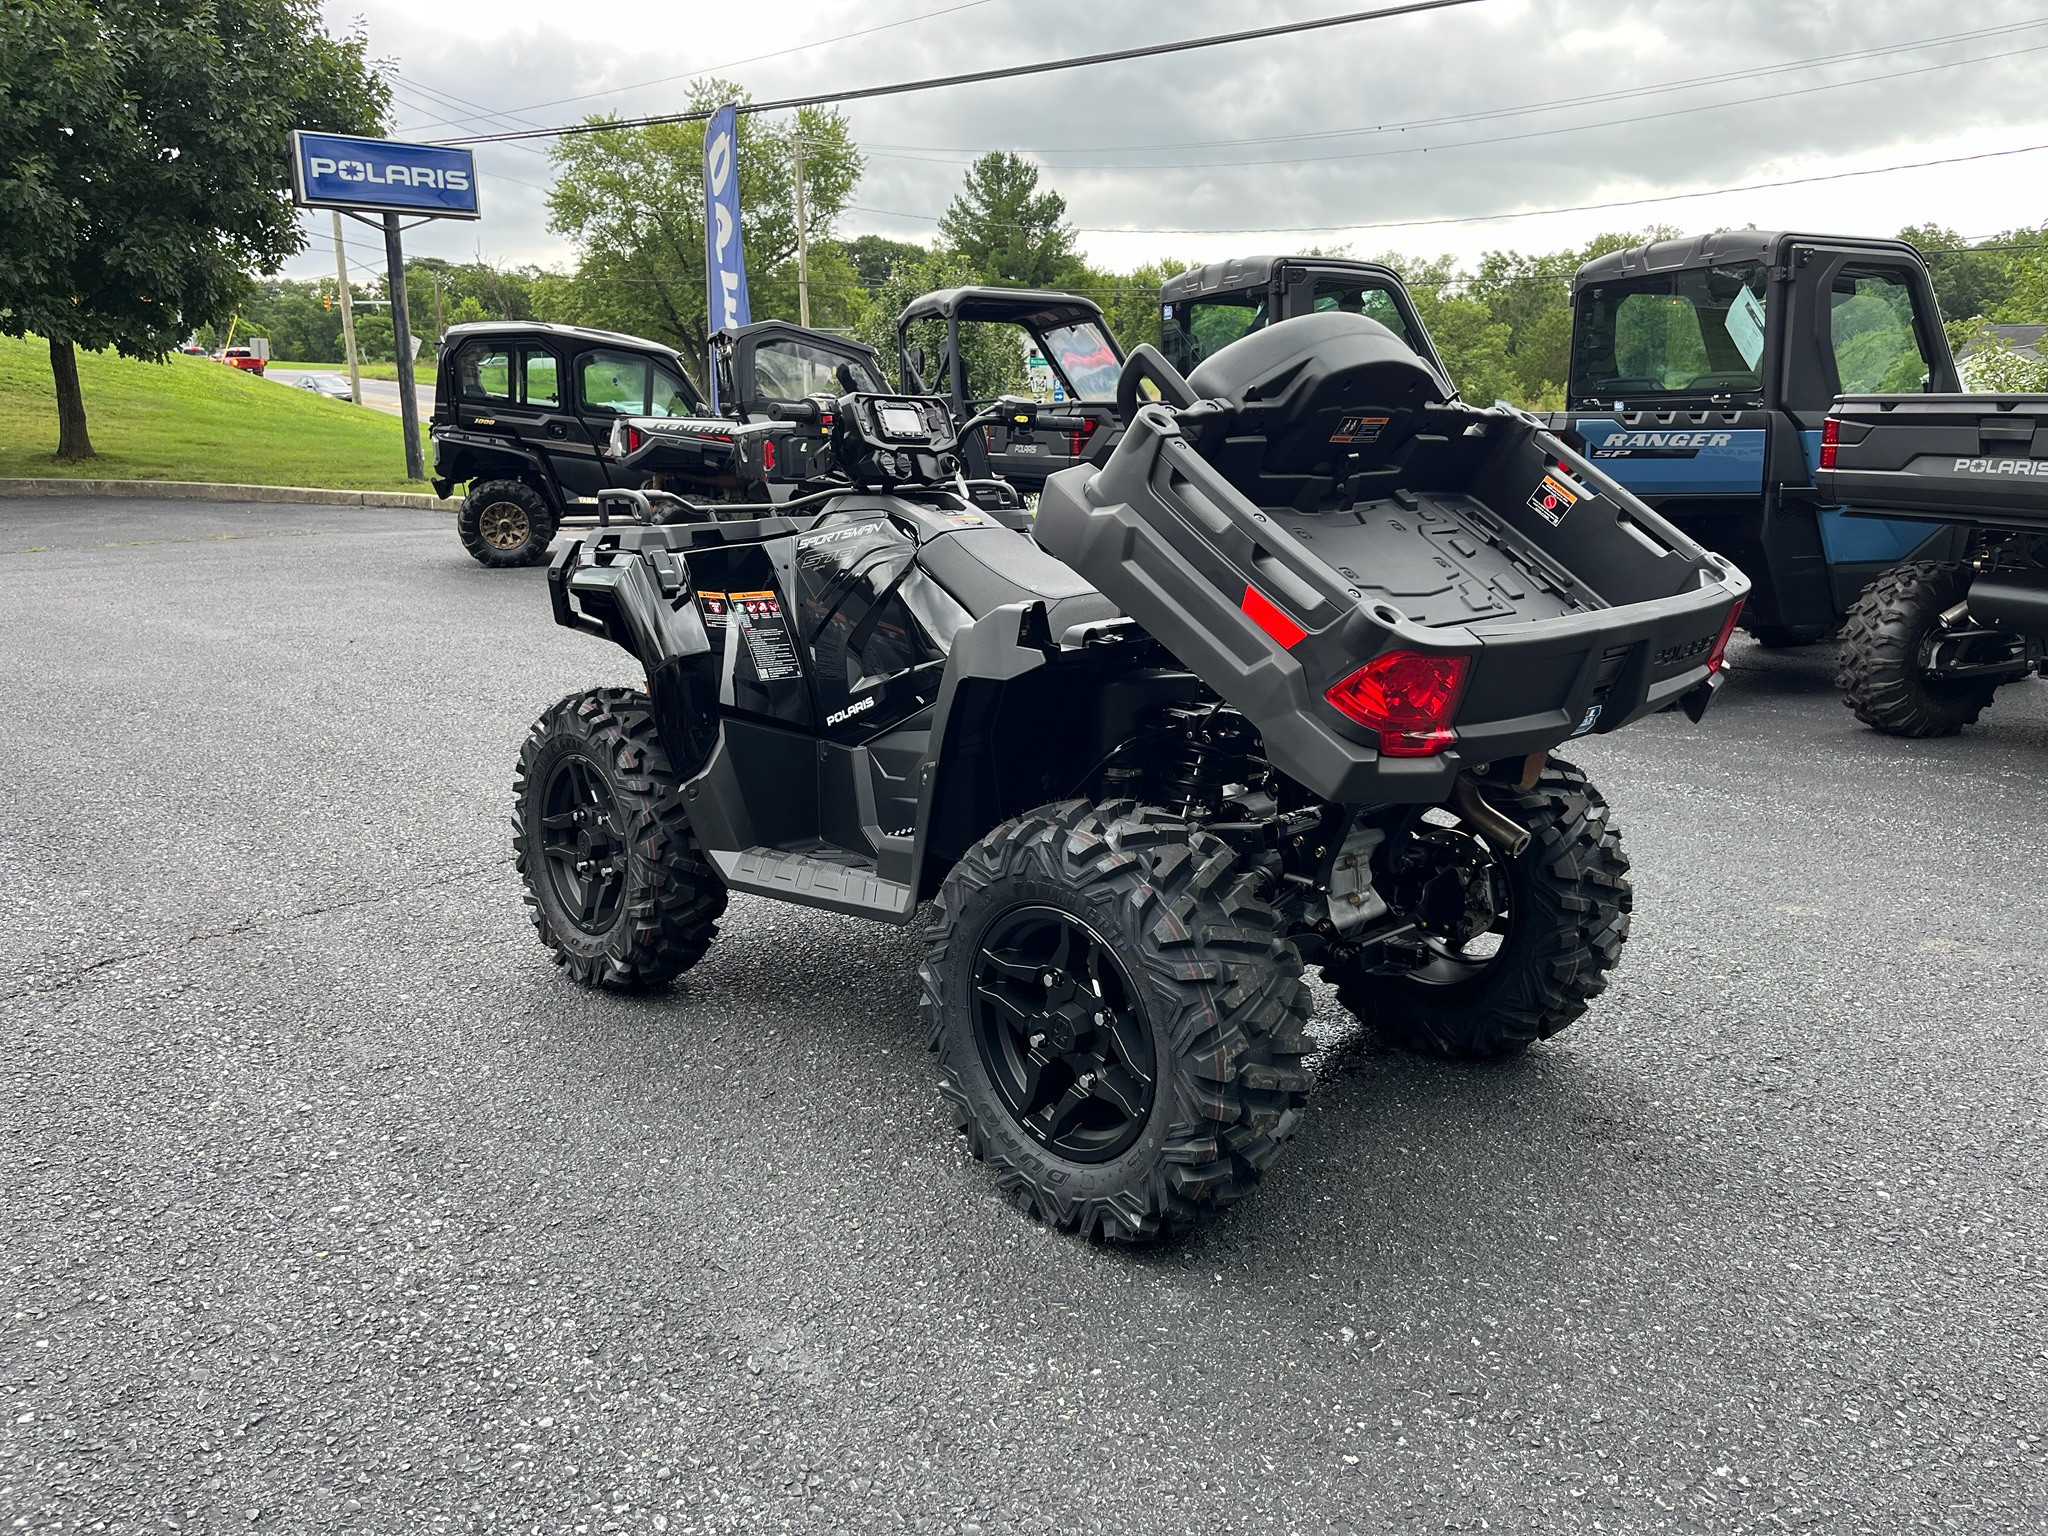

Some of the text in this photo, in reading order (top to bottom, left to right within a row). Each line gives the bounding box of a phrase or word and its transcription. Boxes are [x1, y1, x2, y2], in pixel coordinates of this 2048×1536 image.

[310, 157, 469, 191] POLARIS
[708, 131, 739, 329] OPE
[473, 417, 496, 426] 1000
[1602, 433, 1732, 447] RANGER
[1014, 444, 1037, 454] POLARIS
[1592, 449, 1633, 458] SP
[1953, 458, 2048, 476] POLARIS
[578, 496, 599, 504] YAMA
[797, 521, 884, 550] SPORTSMAN
[826, 696, 875, 727] POLARIS
